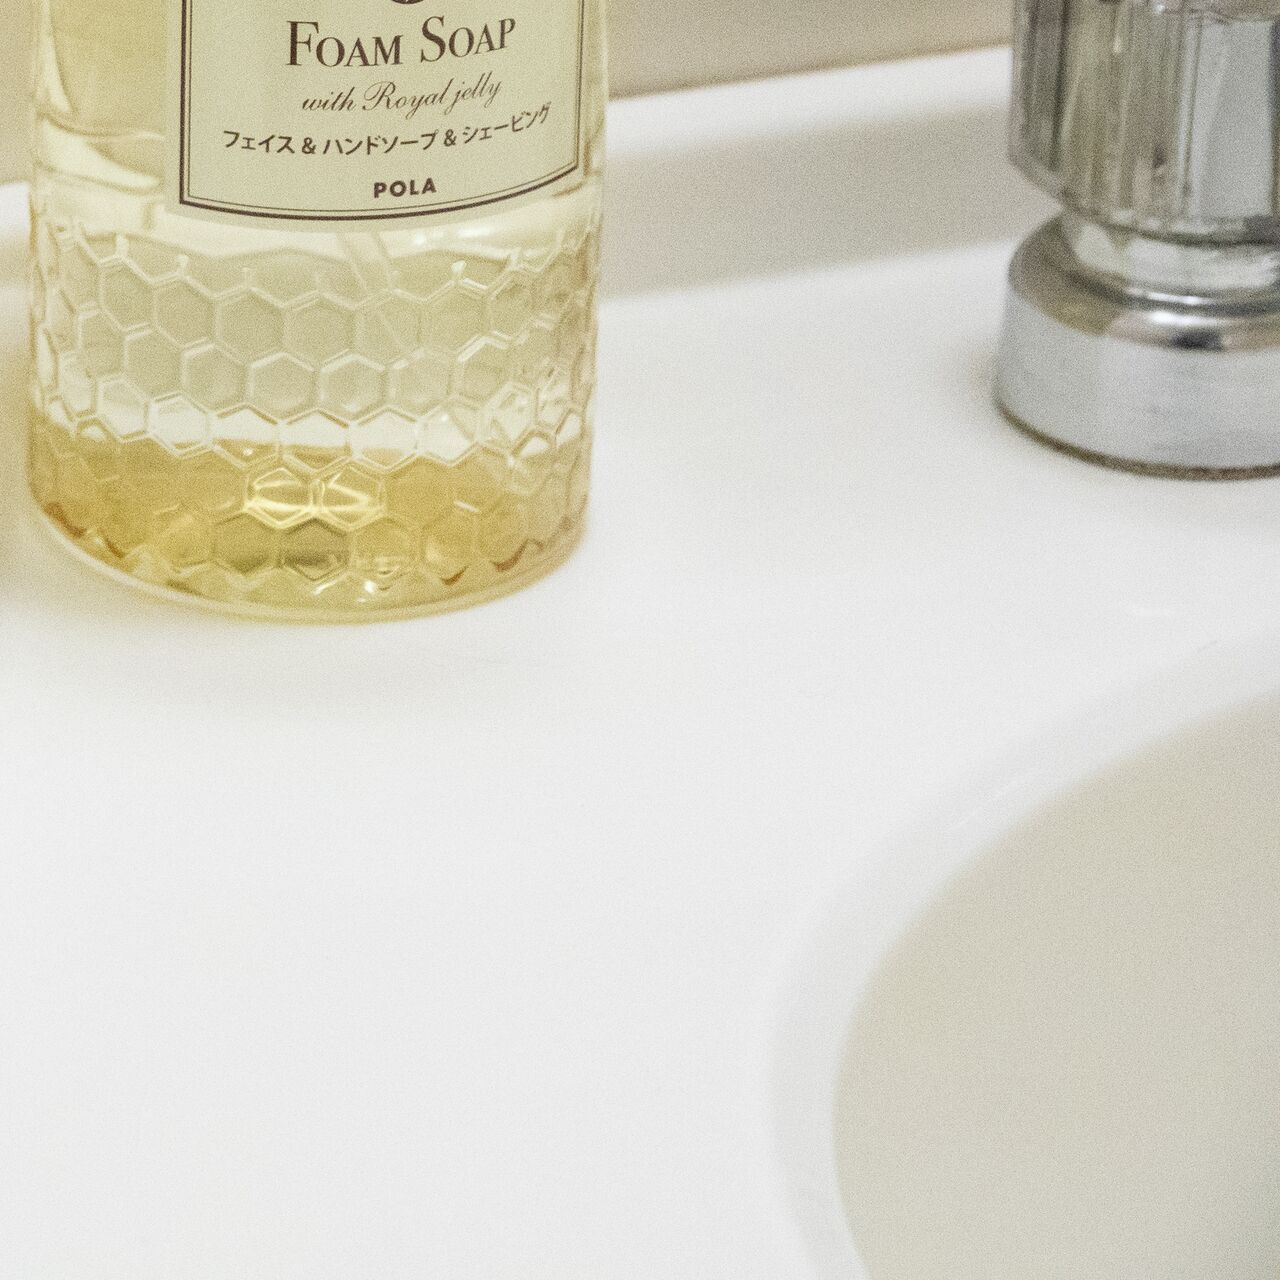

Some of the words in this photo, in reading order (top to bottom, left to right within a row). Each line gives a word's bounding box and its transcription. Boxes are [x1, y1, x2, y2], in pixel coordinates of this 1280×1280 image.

[286, 20, 404, 68] FOAM
[420, 15, 516, 63] SOAP
[301, 86, 357, 113] with
[361, 80, 454, 120] Royal
[444, 70, 503, 116] jelly
[372, 177, 437, 199] POLA
